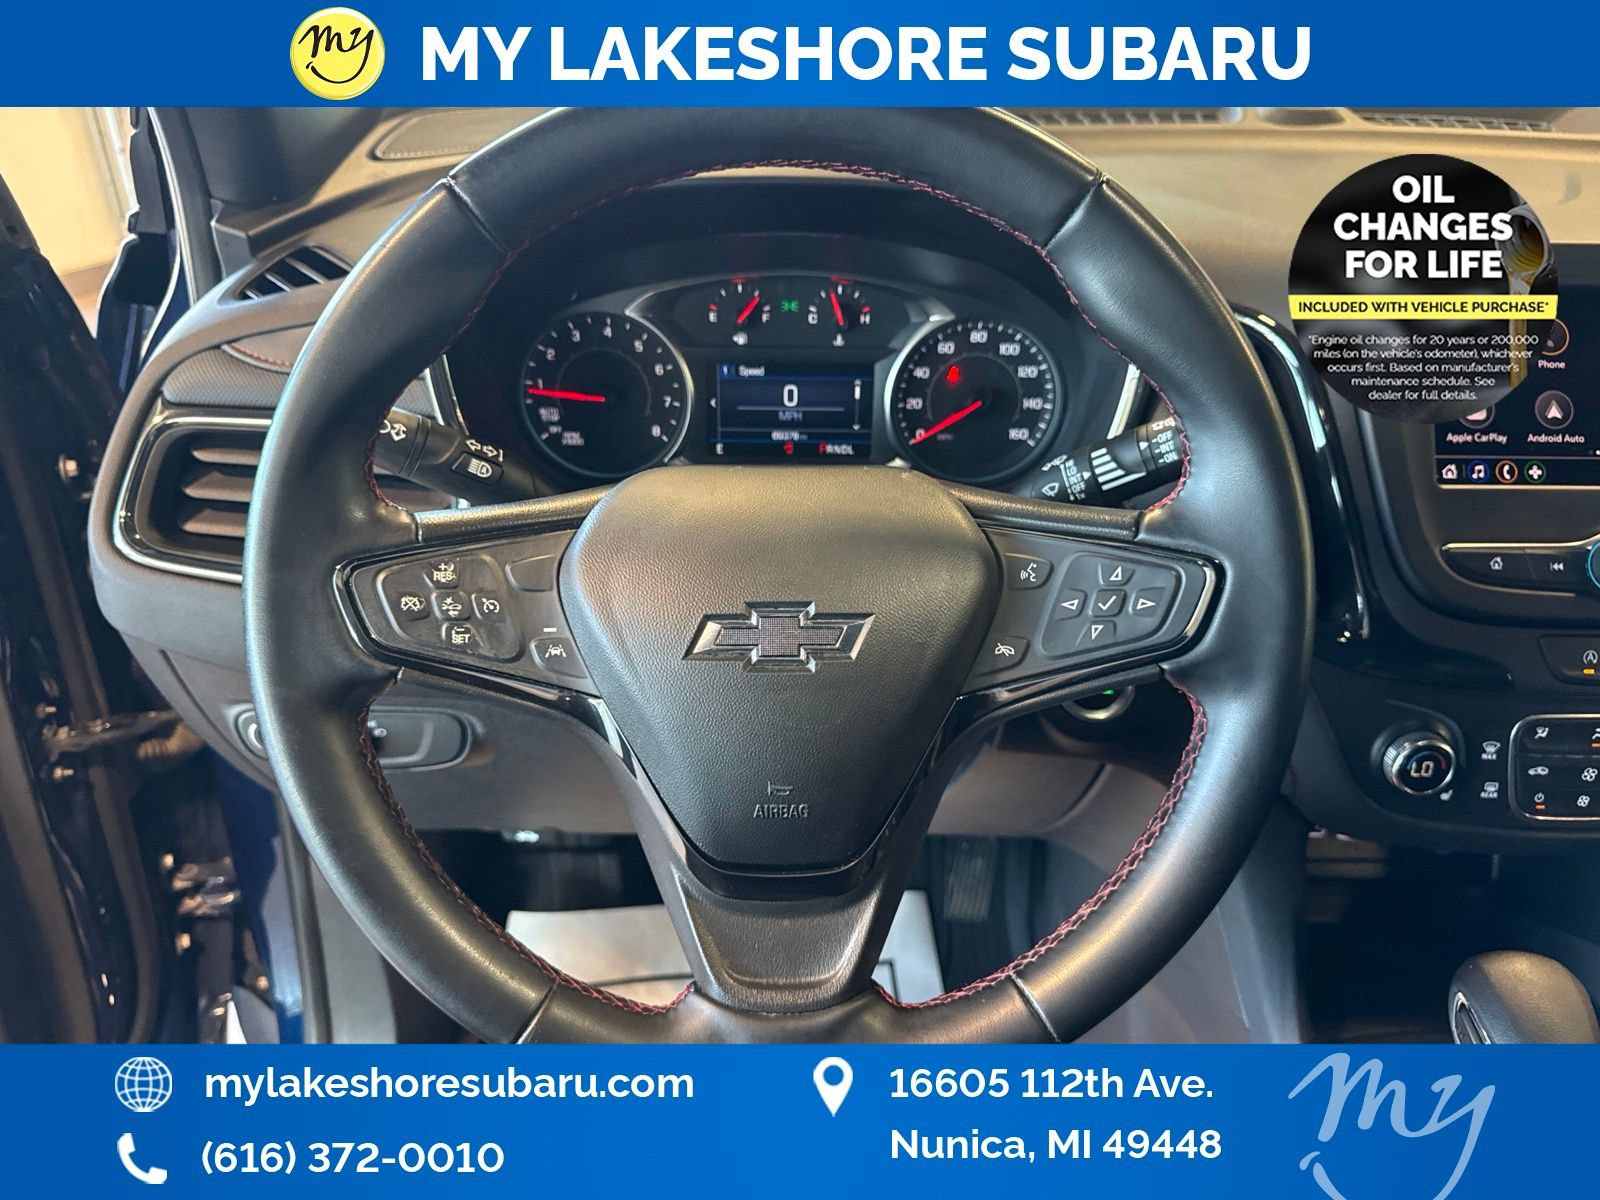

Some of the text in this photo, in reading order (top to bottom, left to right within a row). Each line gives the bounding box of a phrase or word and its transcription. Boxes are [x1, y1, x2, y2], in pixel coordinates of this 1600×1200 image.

[709, 312, 717, 322] E
[762, 312, 770, 323] F
[860, 313, 870, 325] H
[571, 329, 581, 342] 3
[603, 327, 612, 338] 4
[970, 330, 988, 343] 80
[634, 340, 644, 352] 5
[937, 341, 955, 354] 60
[999, 343, 1021, 356] 100
[545, 348, 556, 361] 2
[655, 363, 664, 376] 6
[1538, 360, 1565, 369] Phone
[738, 365, 765, 377] Speed
[913, 366, 930, 379] 40
[1018, 366, 1038, 378] 120
[783, 384, 799, 407] 0
[663, 396, 672, 408] 7
[906, 398, 923, 410] 20
[1022, 398, 1043, 410] 140
[778, 411, 803, 421] MPH
[651, 424, 661, 437] 8
[1009, 428, 1029, 440] 160
[1157, 431, 1174, 444] OFF
[1446, 433, 1508, 444] Apple CarPlay
[1527, 433, 1585, 443] Android Auto
[1160, 441, 1175, 453] INT
[1163, 451, 1179, 463] ON
[1066, 466, 1078, 477] LO
[1069, 475, 1083, 486] INT
[452, 633, 470, 643] SET
[1410, 761, 1434, 777] LO
[752, 803, 809, 818] AIRBAG
